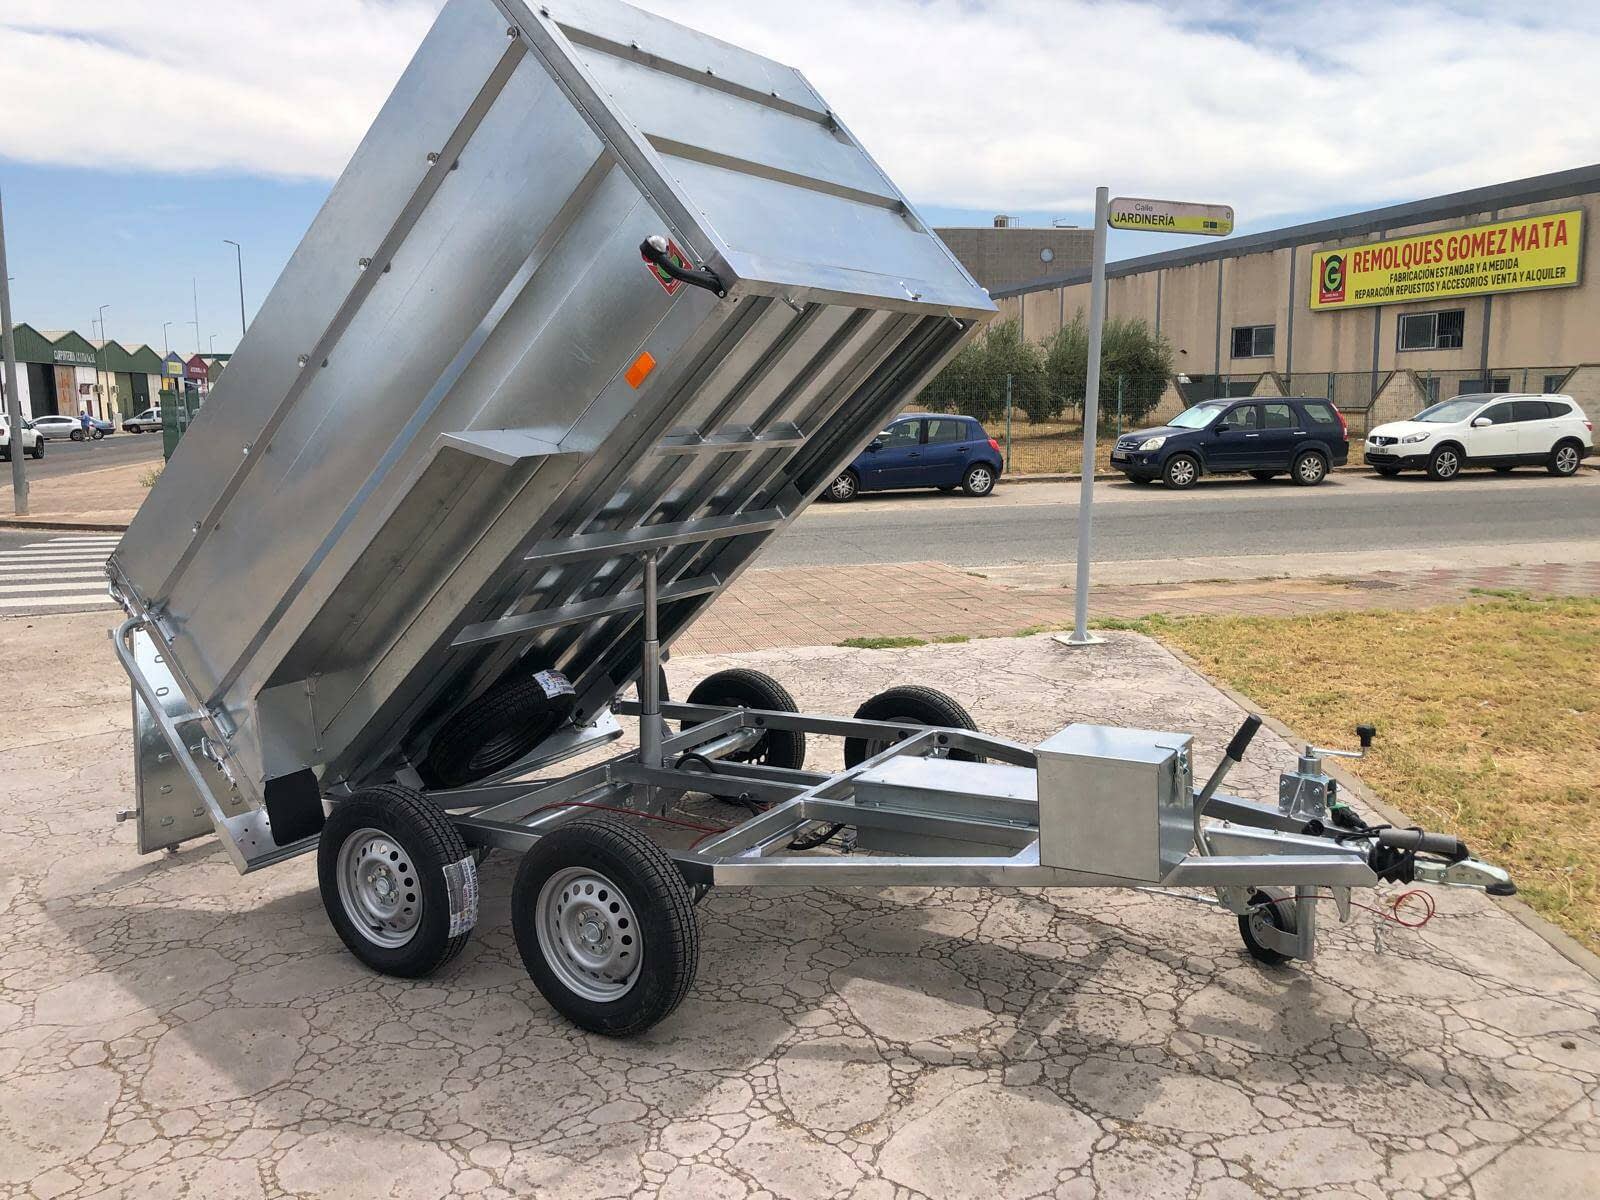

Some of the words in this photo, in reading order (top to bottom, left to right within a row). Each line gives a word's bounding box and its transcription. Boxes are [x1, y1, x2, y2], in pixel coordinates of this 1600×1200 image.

[1114, 213, 1176, 226] JARDINERÍA
[1135, 203, 1153, 212] Calle
[1353, 238, 1444, 273] REMOLQUES
[1446, 228, 1508, 262] GOMEZ
[1510, 219, 1568, 253] MATA
[1354, 283, 1395, 300] REPARACIÓN
[1395, 281, 1435, 296] REPUESTOS
[1435, 281, 1440, 291] Y
[1441, 275, 1489, 291] ACCESORIOS
[1491, 272, 1517, 285] VENTA
[1519, 271, 1525, 282] Y
[1525, 266, 1567, 282] ALQUILER
[1389, 265, 1435, 284] FABRICACIÓN
[1435, 263, 1474, 278] ESTANDAR
[1476, 262, 1481, 273] Y
[1482, 261, 1488, 272] A
[1488, 257, 1519, 272] MEDIDA
